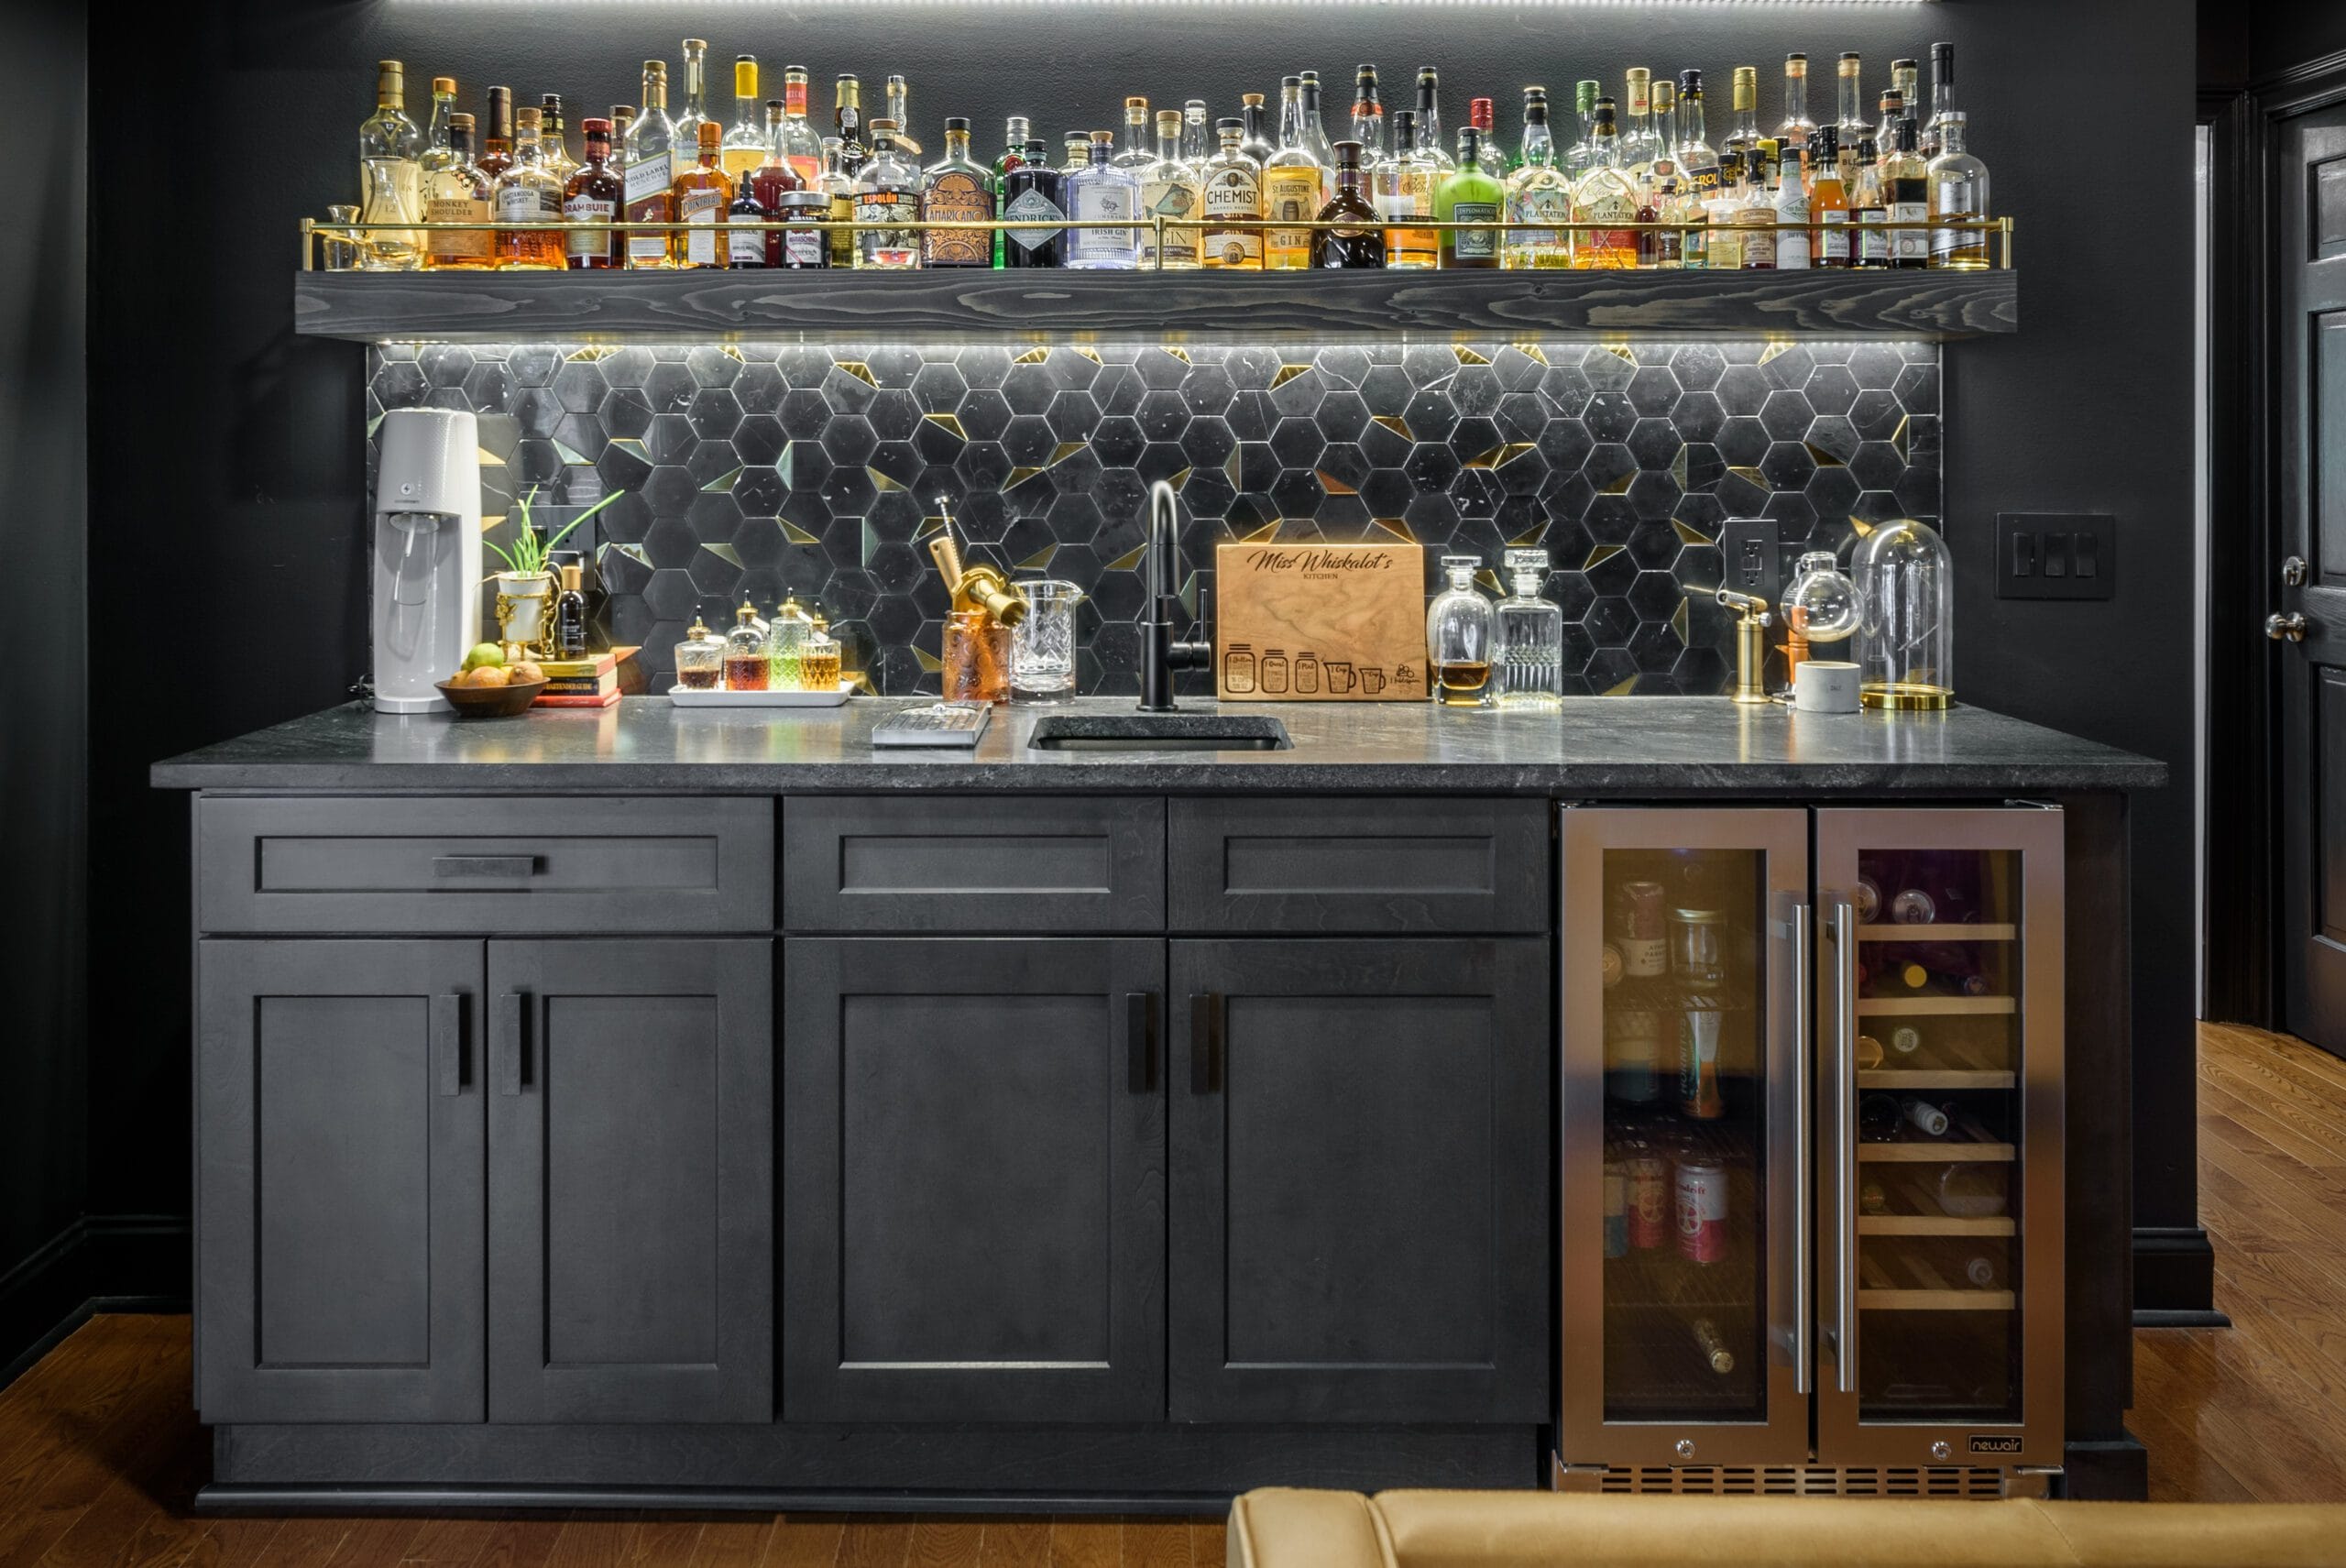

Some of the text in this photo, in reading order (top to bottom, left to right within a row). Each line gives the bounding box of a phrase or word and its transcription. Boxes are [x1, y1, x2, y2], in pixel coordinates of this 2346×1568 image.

[645, 163, 670, 176] LABEL
[1675, 173, 1718, 196] AEROL
[1207, 190, 1257, 204] CHEMIST
[683, 194, 721, 215] COINTREAU
[431, 207, 473, 216] SHOULDER
[929, 209, 985, 222] AMARICANO
[1526, 210, 1566, 219] PLATATION
[1280, 236, 1301, 246] GIN
[1246, 549, 1394, 573] Miss Whiskalot's
[1972, 1439, 2021, 1452] newair
